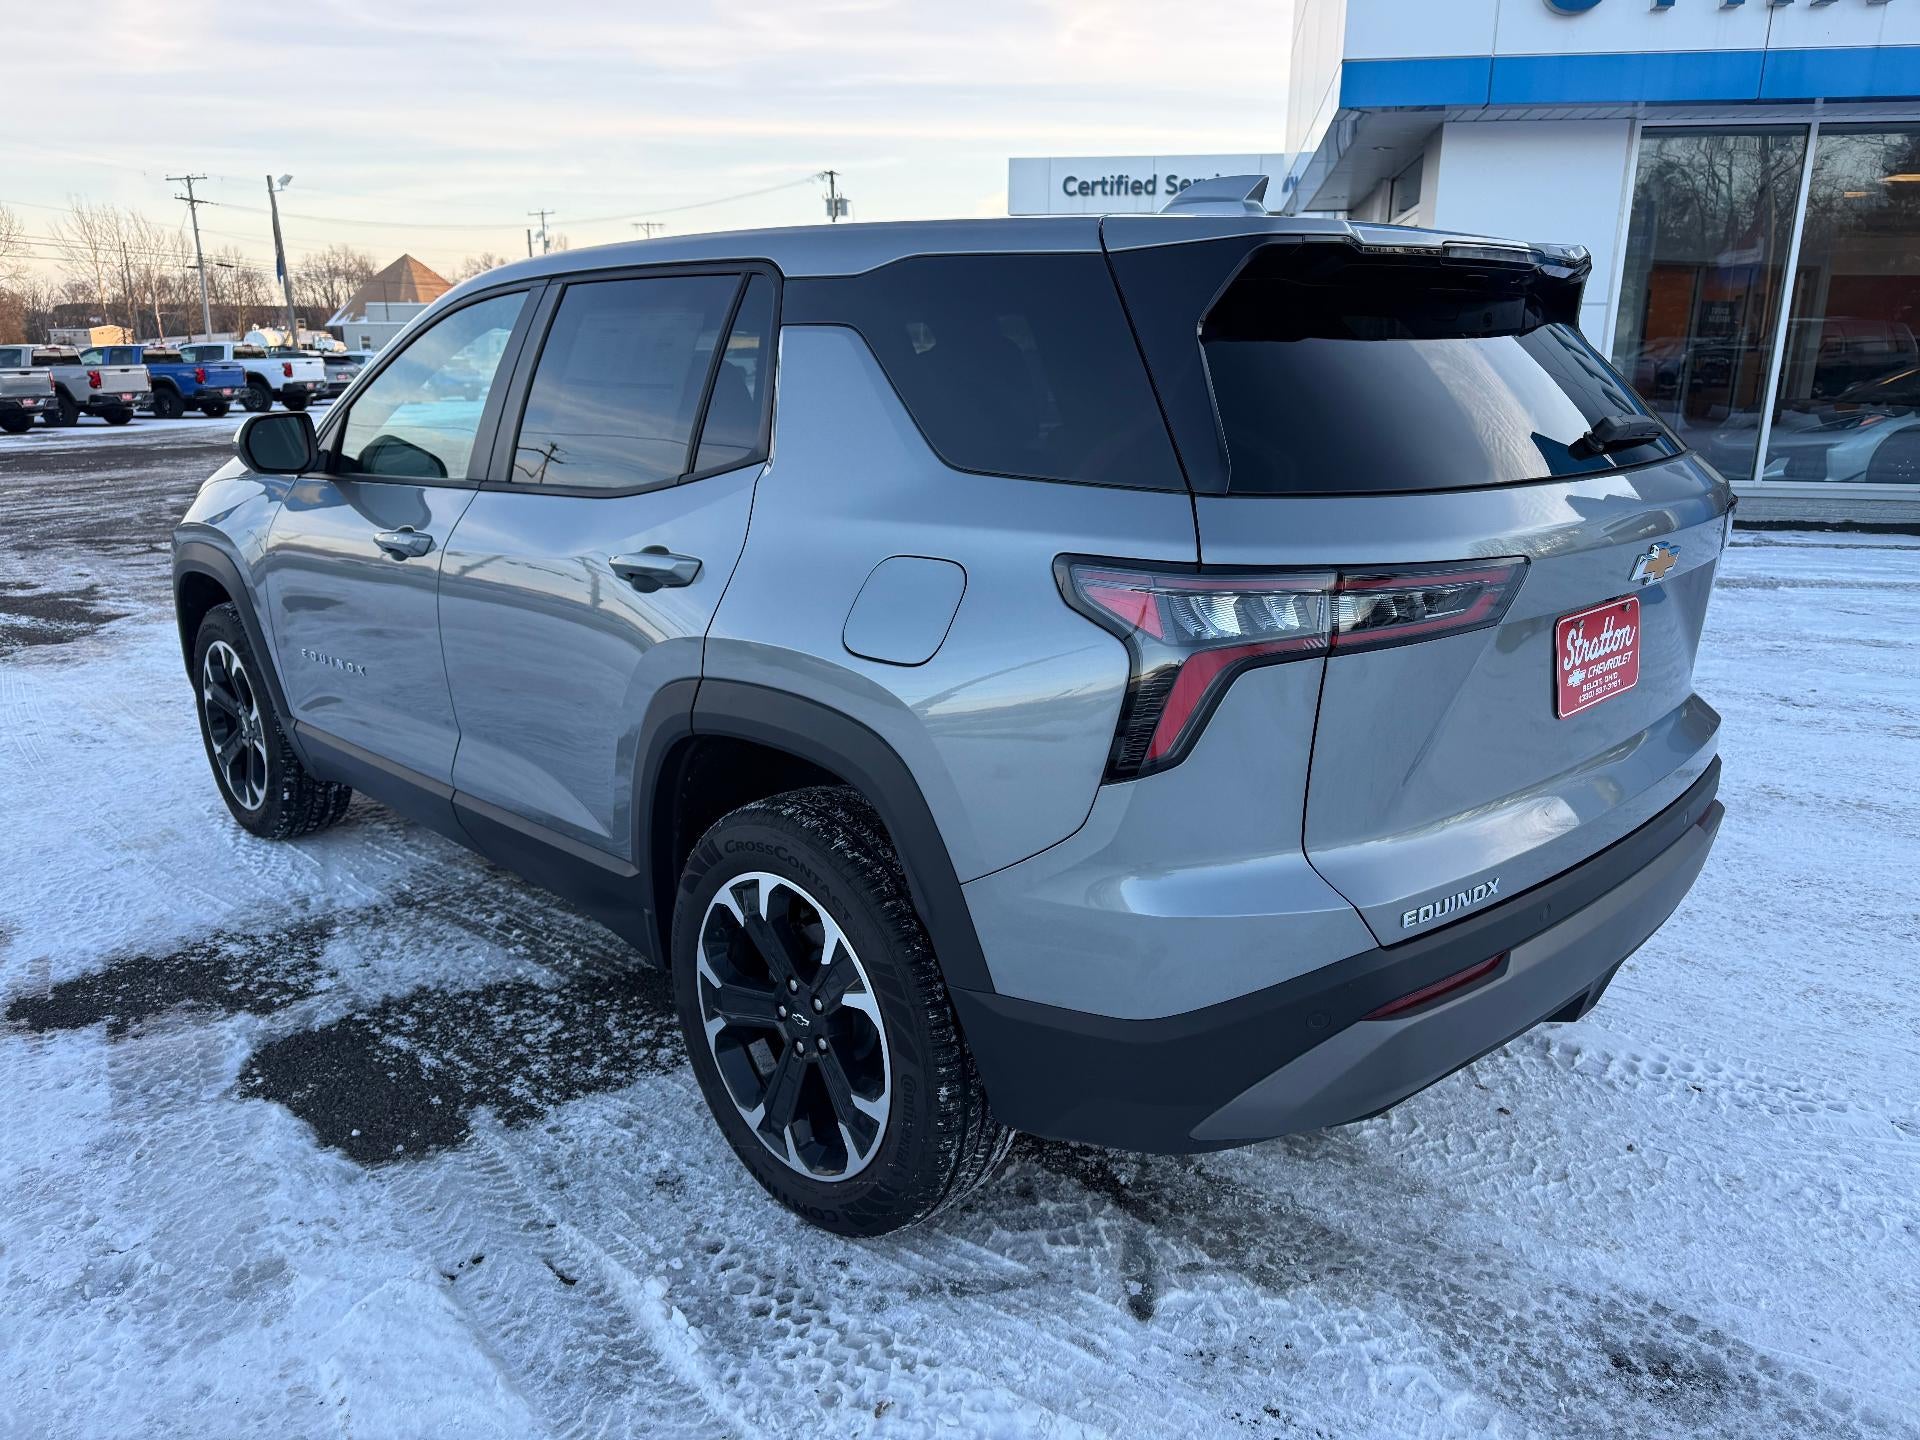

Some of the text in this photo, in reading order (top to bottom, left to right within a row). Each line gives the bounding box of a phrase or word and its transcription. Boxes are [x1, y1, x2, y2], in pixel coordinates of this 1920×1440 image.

[1062, 174, 1156, 197] Certified
[1563, 616, 1636, 671] Stratton
[302, 648, 366, 677] EQUINOX
[1587, 651, 1633, 679] CHEVROLET
[1401, 877, 1500, 929] EQUINOX
